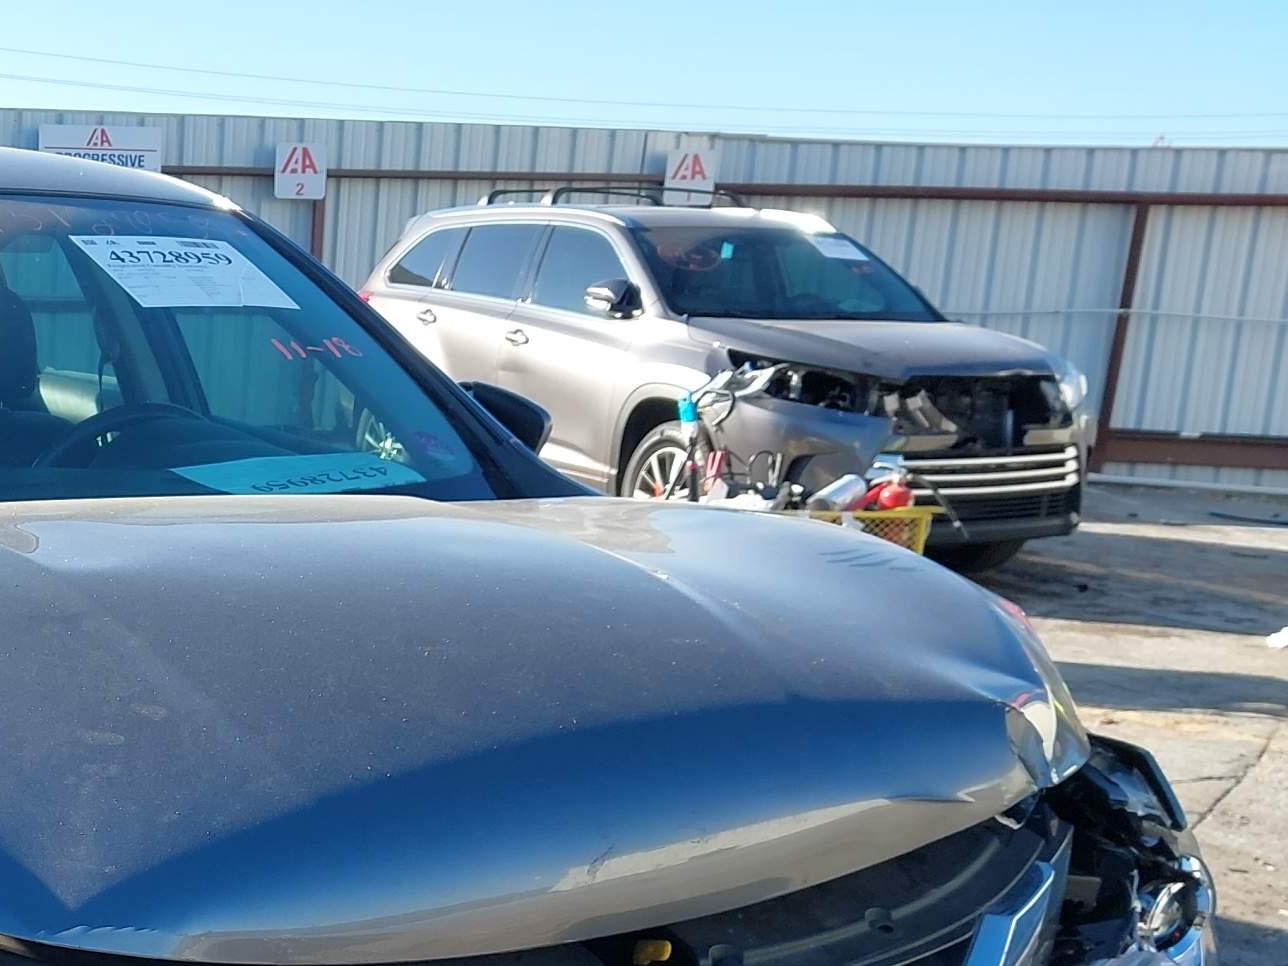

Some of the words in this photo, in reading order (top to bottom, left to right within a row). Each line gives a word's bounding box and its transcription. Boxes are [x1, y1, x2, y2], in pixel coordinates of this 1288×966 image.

[295, 182, 305, 196] 2
[109, 249, 233, 266] 43728959
[251, 465, 388, 493] 43728959
